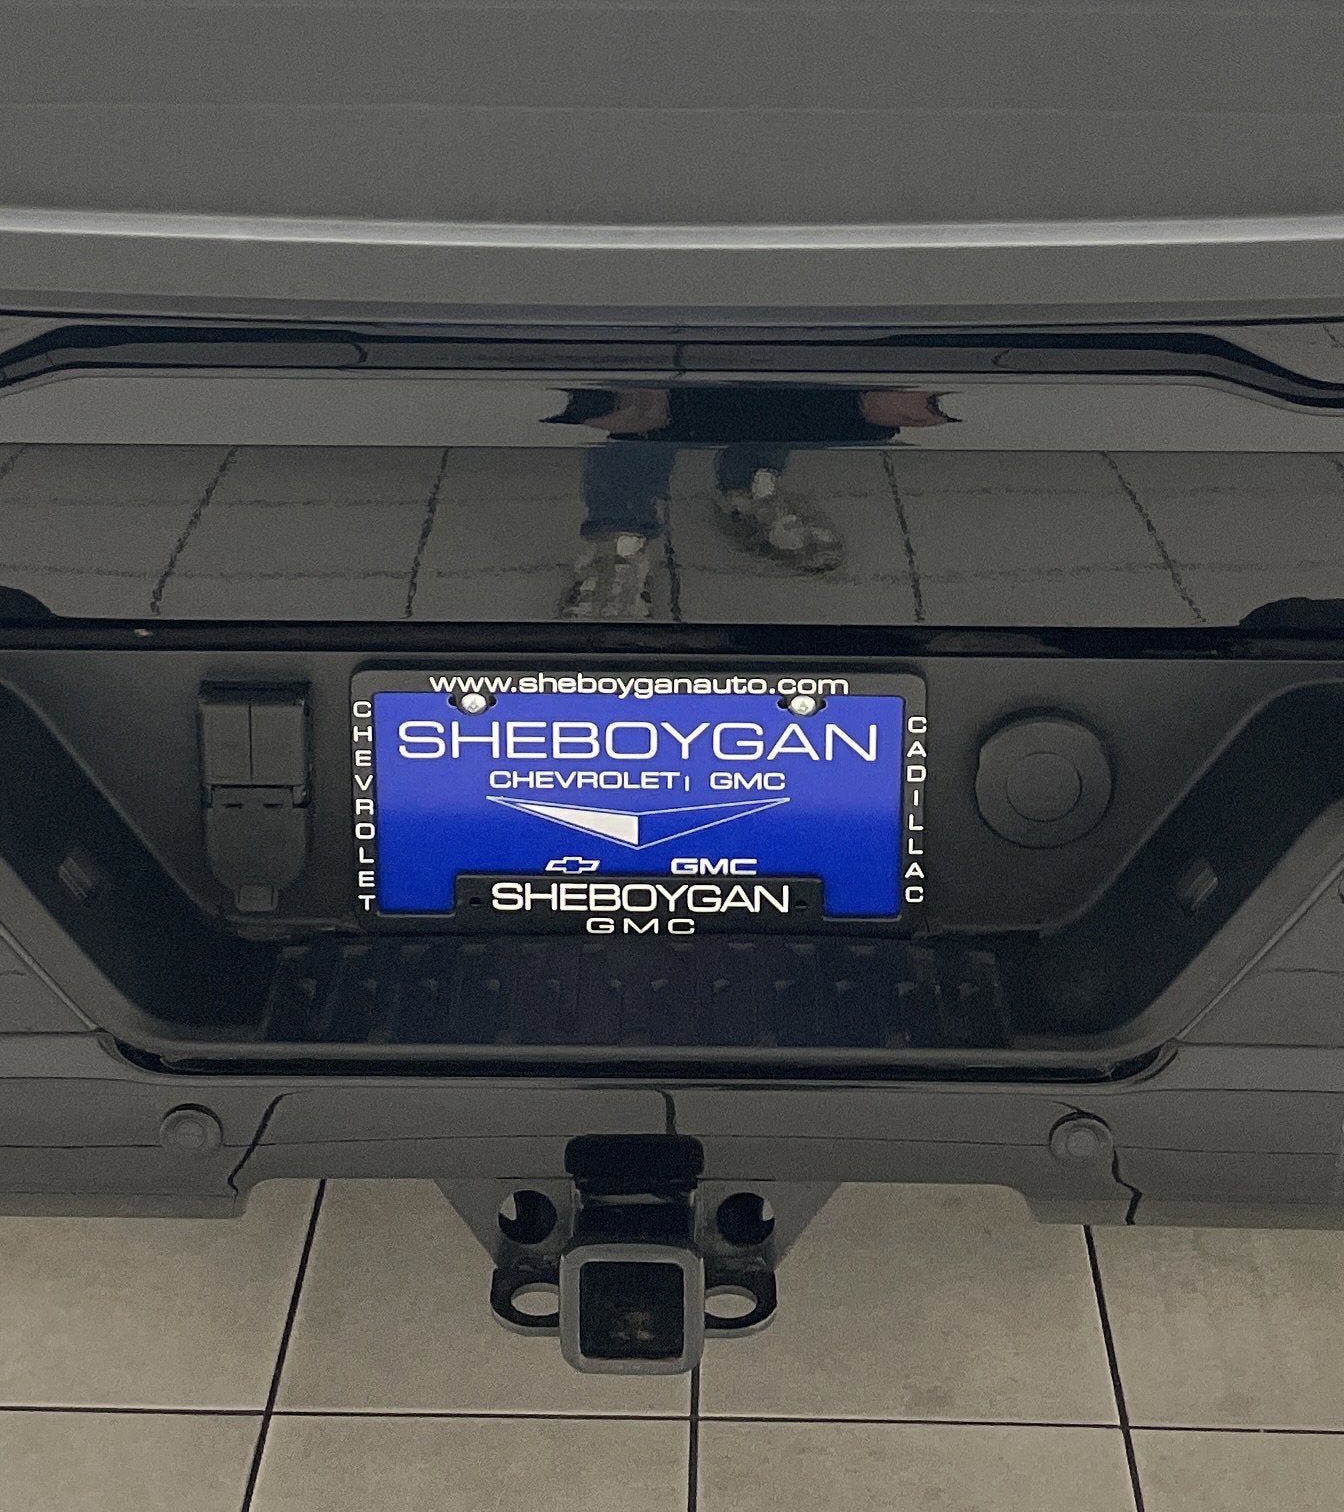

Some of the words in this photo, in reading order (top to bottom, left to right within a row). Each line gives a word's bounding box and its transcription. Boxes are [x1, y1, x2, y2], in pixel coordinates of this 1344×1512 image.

[428, 672, 850, 700] www.sheboyganauto.com
[397, 720, 878, 763] SHEBOYGAN
[489, 770, 681, 790] CHEVROLET
[709, 771, 786, 791] GMC
[351, 700, 376, 912] CHEVROLET
[904, 716, 928, 904] CADILLAC
[670, 857, 758, 876] GMC
[491, 882, 789, 913] SHEBOYGAN
[586, 917, 695, 935] GMC
